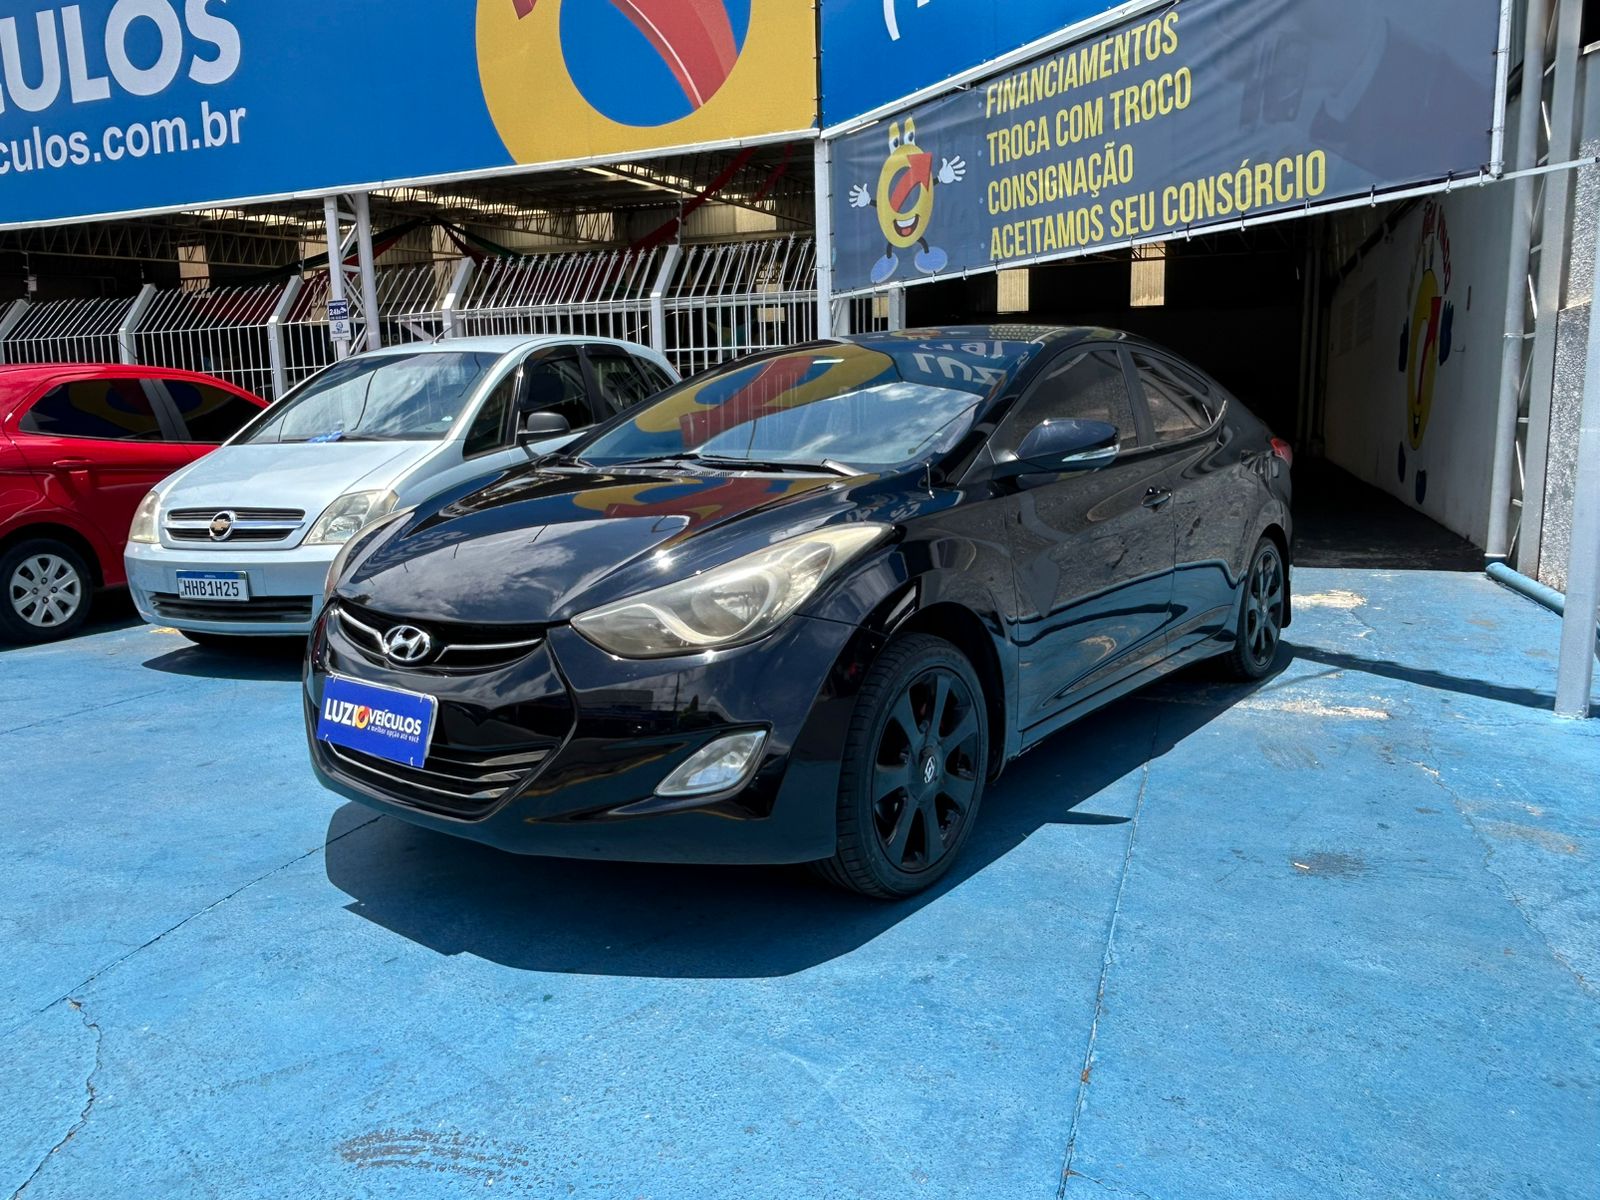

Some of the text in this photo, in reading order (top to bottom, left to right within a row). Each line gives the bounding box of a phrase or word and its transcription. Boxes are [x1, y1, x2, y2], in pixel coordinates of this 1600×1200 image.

[0, 0, 241, 114] ULOS
[986, 11, 1179, 119] FINANCIAMENTOS
[986, 66, 1192, 167] TROCA COM TROCO
[987, 140, 1134, 216] CONSIGNAÇÃO
[989, 149, 1326, 261] ACEITAMOS SEU CONSÓRCIO
[183, 580, 239, 597] HHB1H25
[369, 708, 422, 736] VEÍCULOS
